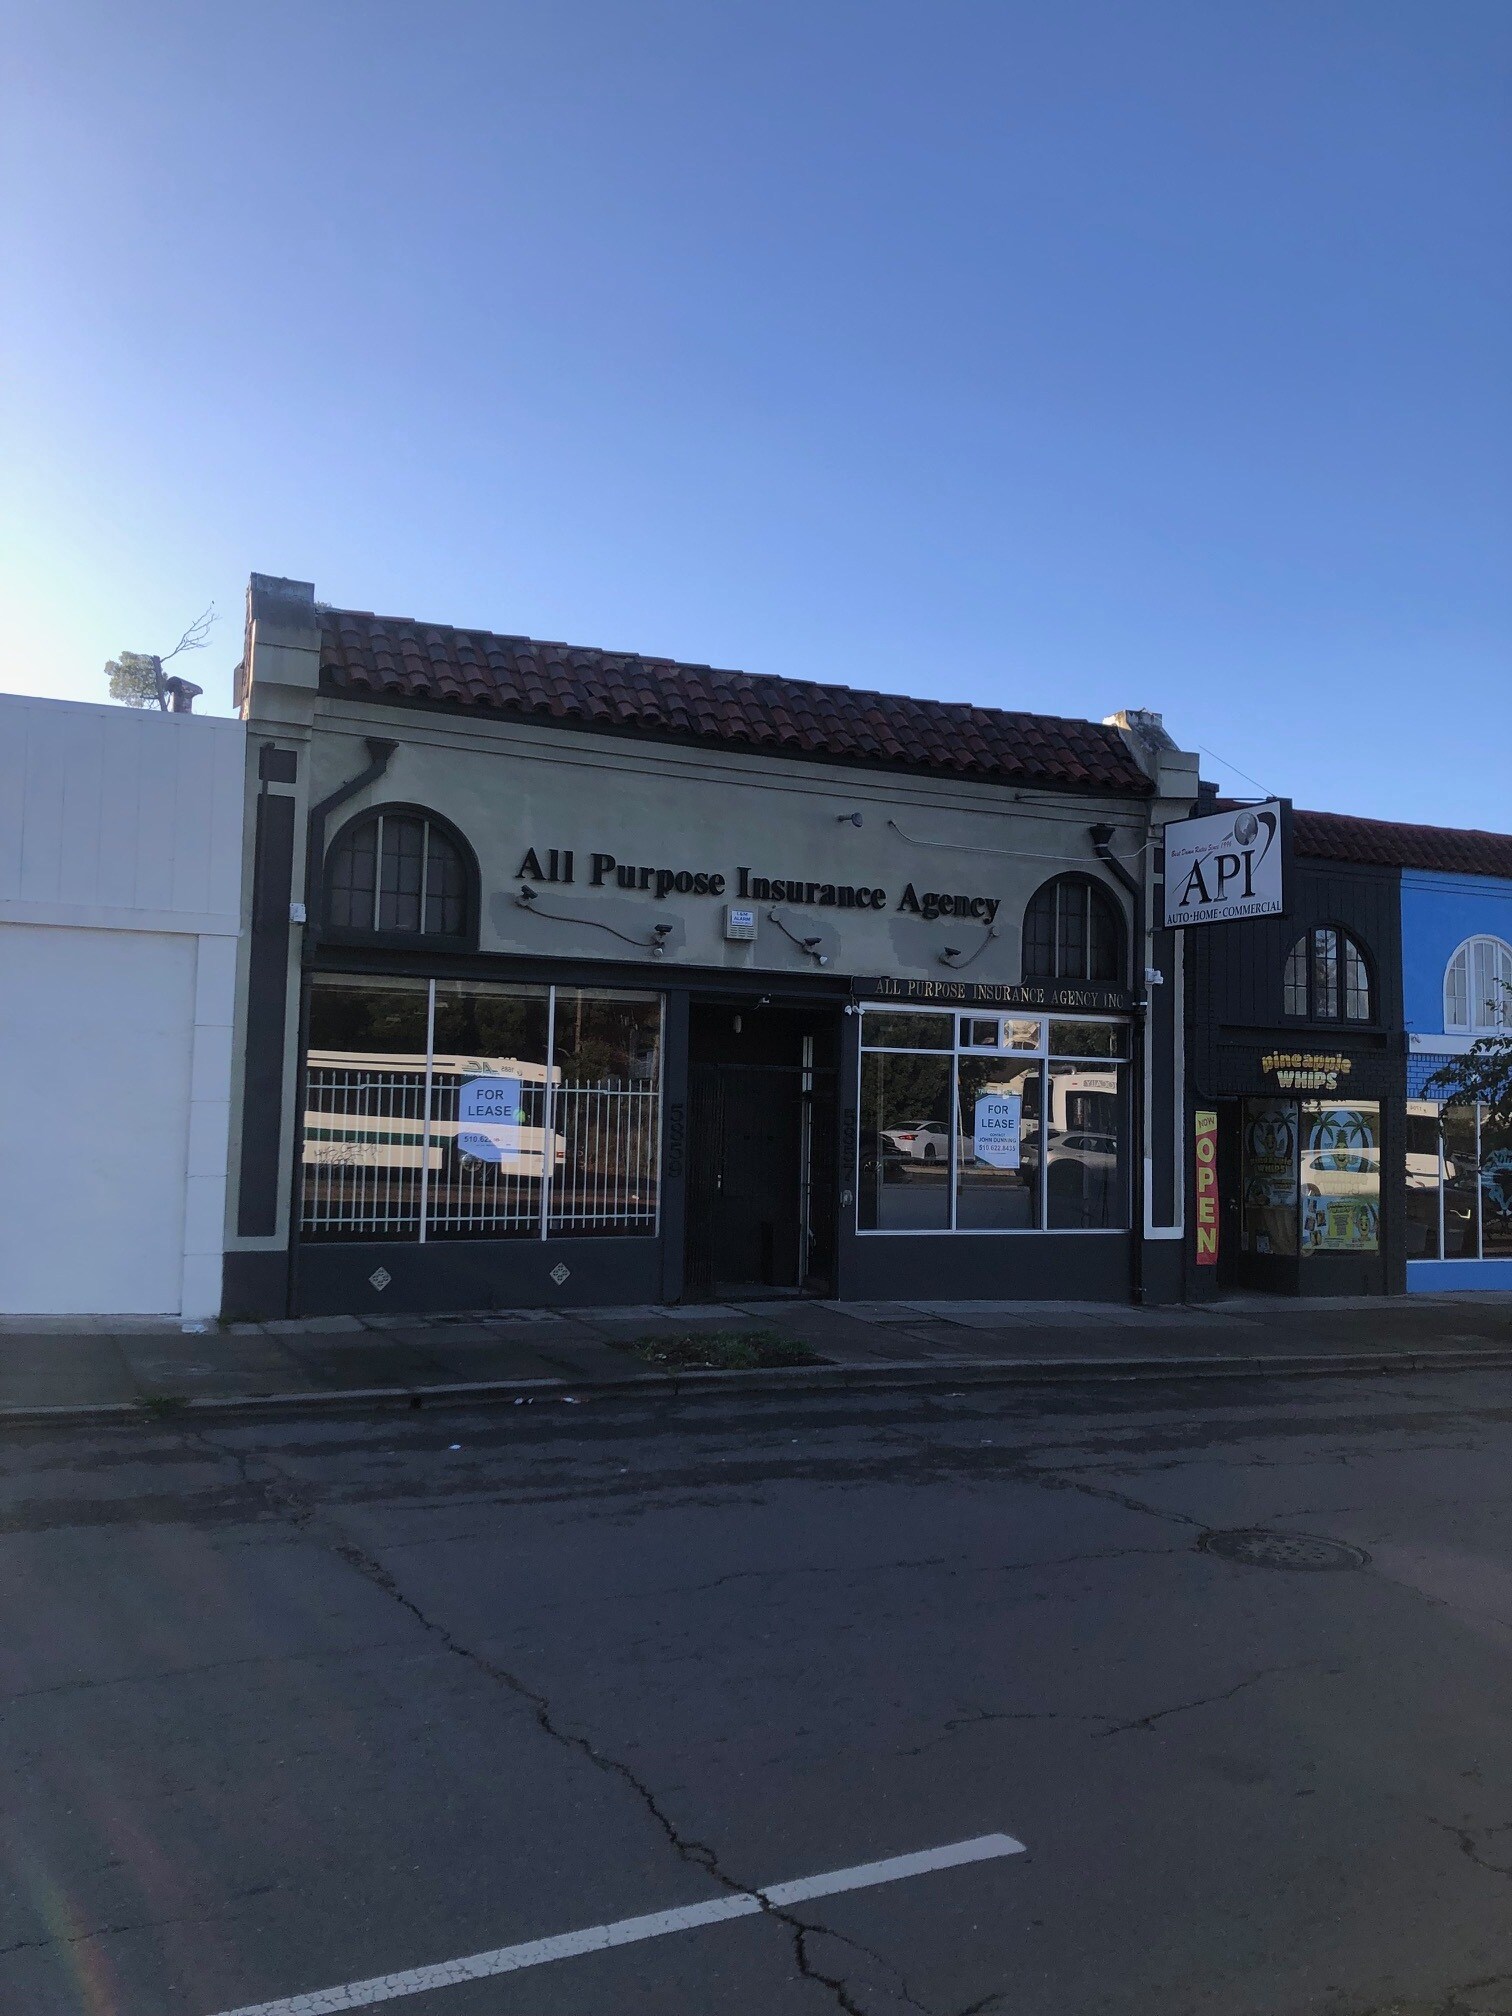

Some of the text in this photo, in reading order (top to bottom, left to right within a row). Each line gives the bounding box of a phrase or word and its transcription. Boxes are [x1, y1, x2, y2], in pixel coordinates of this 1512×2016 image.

[515, 847, 1001, 924] All Purpose Insurance Agency
[1179, 850, 1256, 907] API
[875, 979, 1124, 1009] ALL PURPOSE INSURANCE AGENCY INC
[1262, 1050, 1352, 1074] pineapple
[1276, 1070, 1338, 1090] WHIPS
[476, 1089, 504, 1100] FOR
[467, 1105, 512, 1116] LEASE
[987, 1104, 1009, 1115] FOR
[981, 1119, 1015, 1129] LEASE
[1198, 1116, 1215, 1128] NOW
[1197, 1137, 1217, 1253] OPEN
